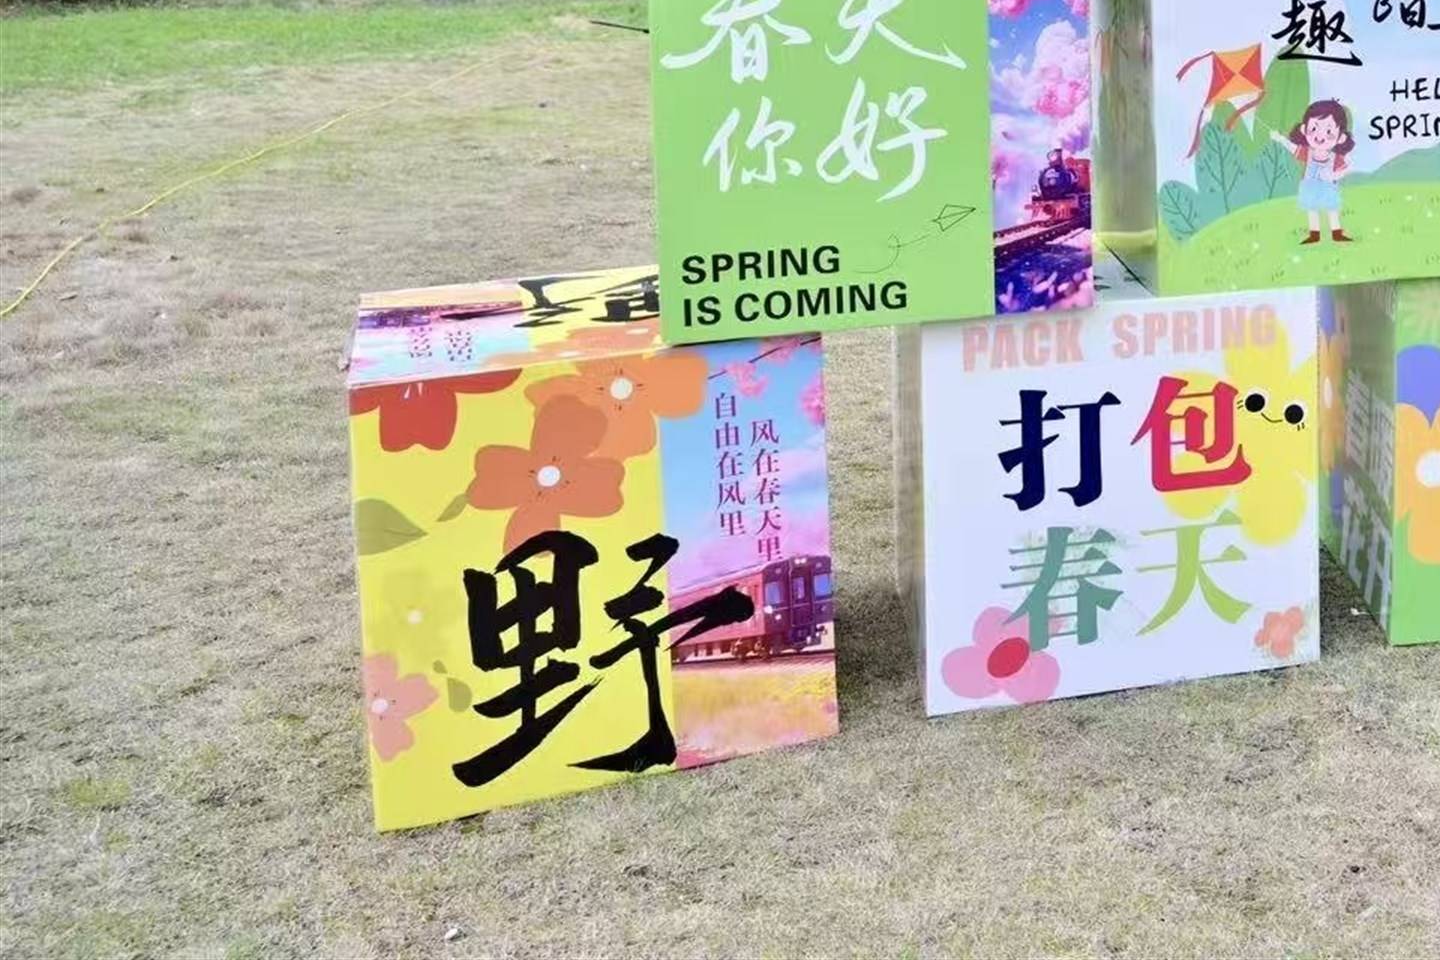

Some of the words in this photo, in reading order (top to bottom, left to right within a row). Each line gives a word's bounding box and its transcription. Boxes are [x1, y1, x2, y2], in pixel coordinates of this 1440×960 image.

[702, 77, 948, 203] 你好
[681, 245, 841, 285] SPRING
[683, 296, 722, 327] IS
[734, 281, 908, 320] COMING
[962, 317, 1084, 373] PACK
[1112, 304, 1278, 359] SPRING
[713, 391, 747, 538] 自由在风里
[750, 419, 785, 562] 风在春天里
[998, 375, 1252, 511] 打包
[1000, 509, 1252, 652] 春天
[452, 530, 755, 787] 野
